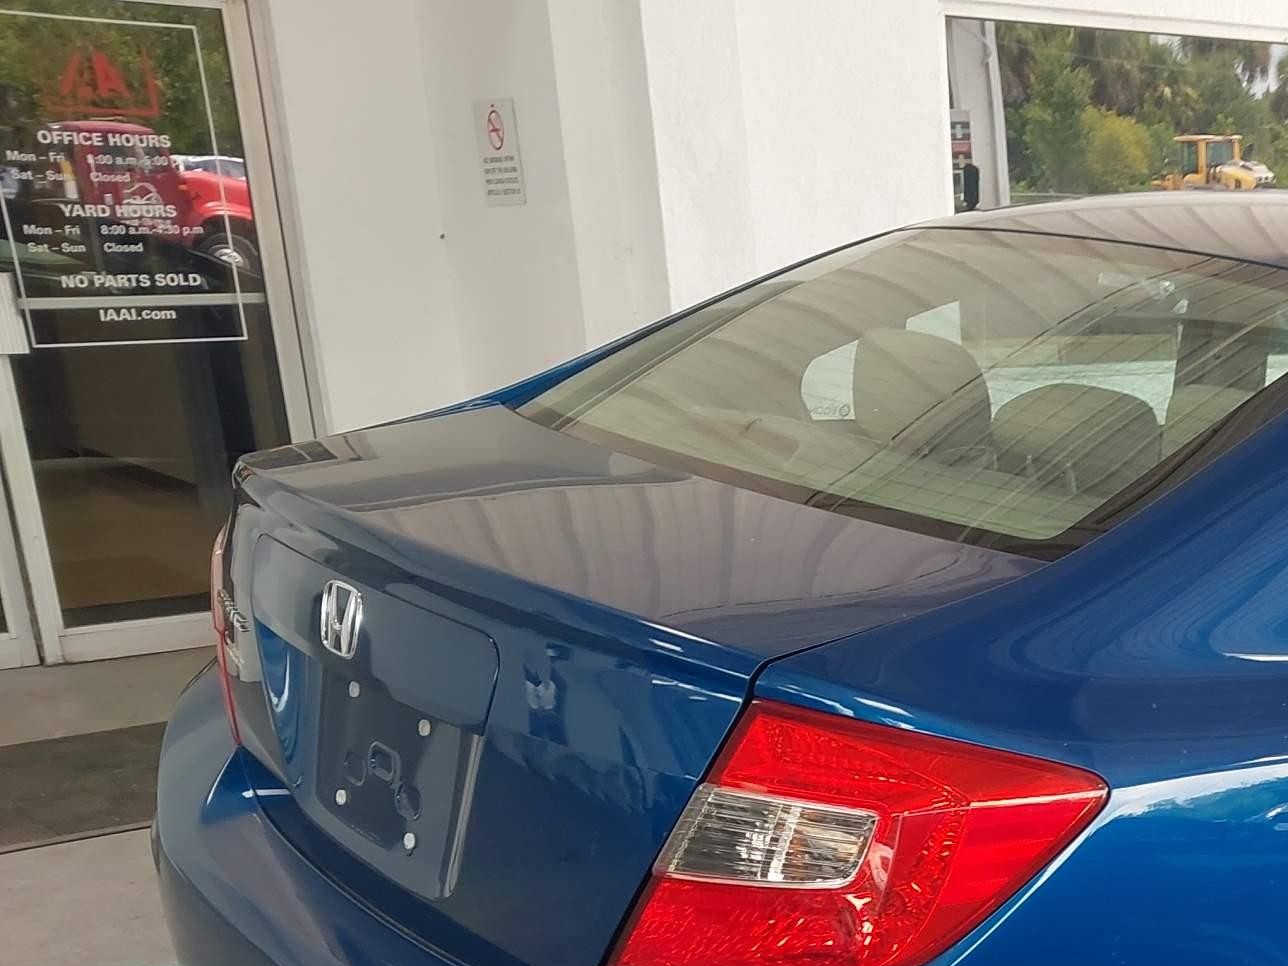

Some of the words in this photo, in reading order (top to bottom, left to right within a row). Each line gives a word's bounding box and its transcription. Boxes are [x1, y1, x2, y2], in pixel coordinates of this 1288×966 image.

[37, 130, 104, 146] OFFICE
[109, 132, 172, 148] HOURS
[6, 151, 37, 162] Mon
[49, 152, 65, 163] Fri
[11, 170, 33, 180] Sat
[46, 171, 69, 181] Su
[90, 172, 131, 182] Closed
[62, 204, 110, 218] YARD
[116, 204, 177, 218] HOURS
[23, 225, 53, 235] Mon
[64, 225, 81, 235] Fri
[100, 225, 126, 235] 8:00
[28, 243, 50, 252] Sat
[62, 243, 86, 252] Sun
[104, 243, 144, 252] Closed
[61, 275, 89, 288] NO
[94, 274, 151, 287] PARTS
[155, 273, 201, 286] SOLD
[99, 308, 177, 321] IAAI.com
